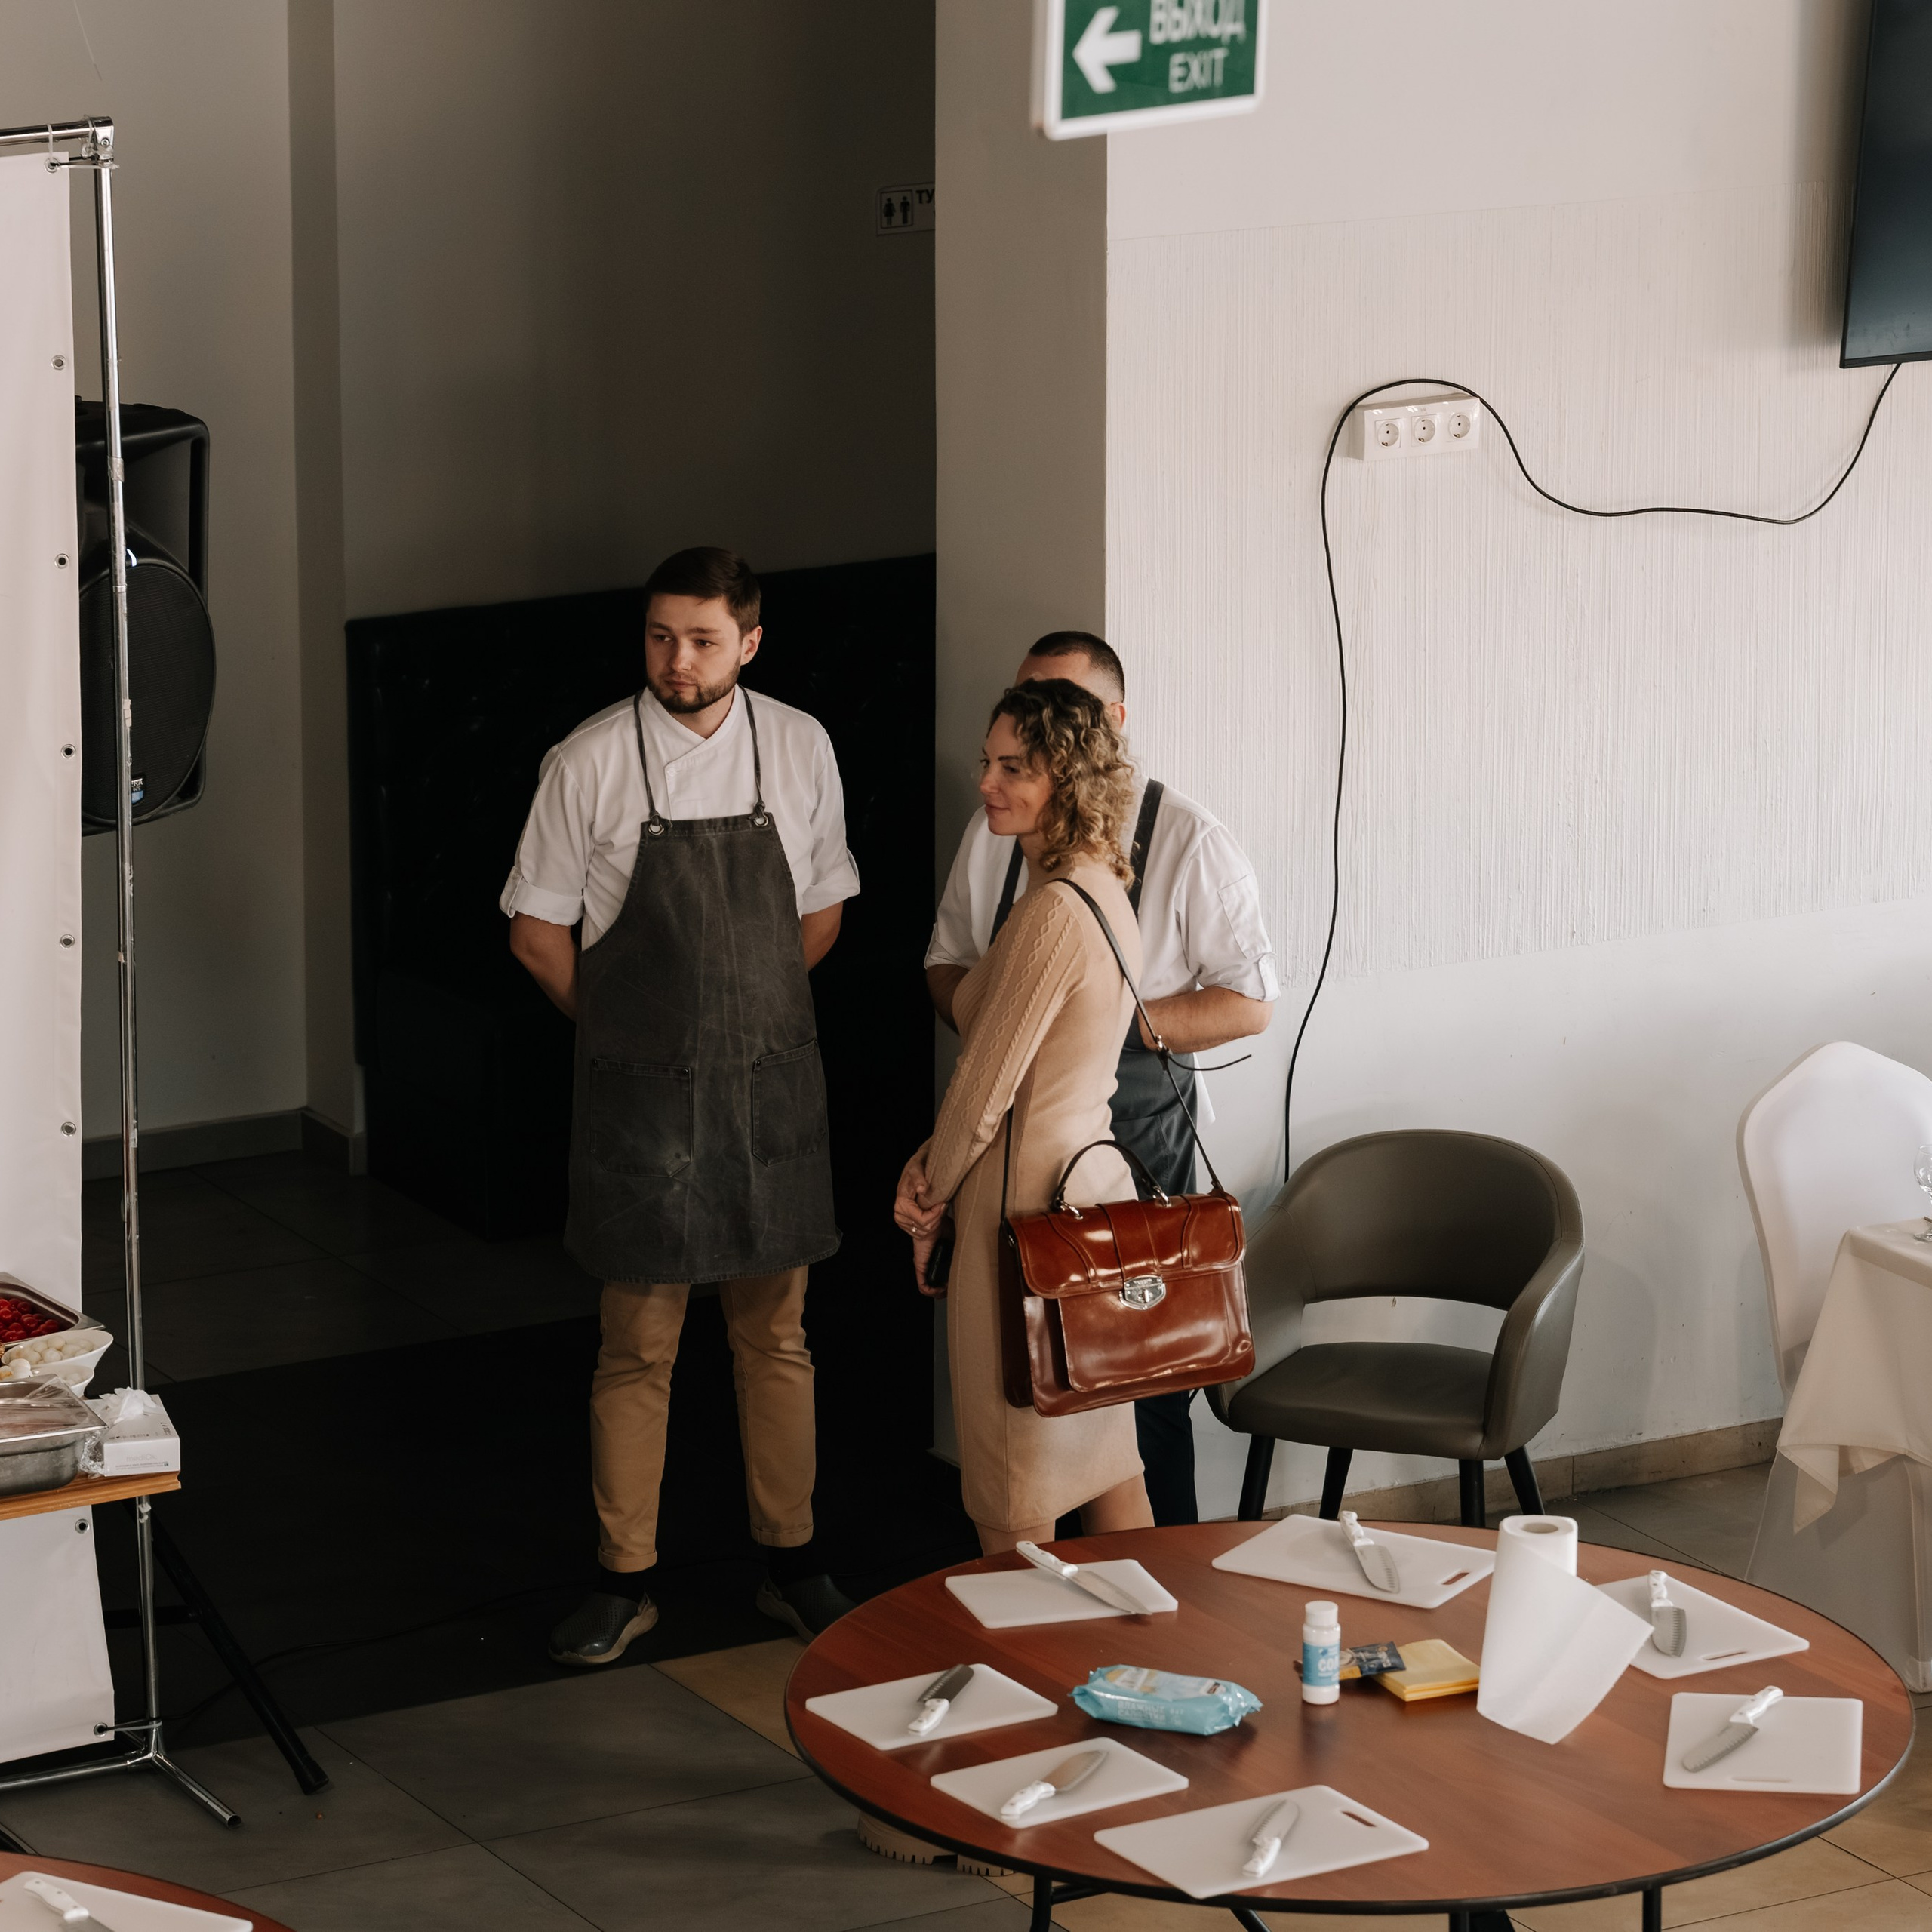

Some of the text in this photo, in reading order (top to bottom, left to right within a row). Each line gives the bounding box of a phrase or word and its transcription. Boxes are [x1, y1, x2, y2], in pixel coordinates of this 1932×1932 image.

[1149, 0, 1247, 45] ВЫХОД
[1169, 47, 1229, 94] EXIT
[1118, 1709, 1165, 1721] САЛТКИ
